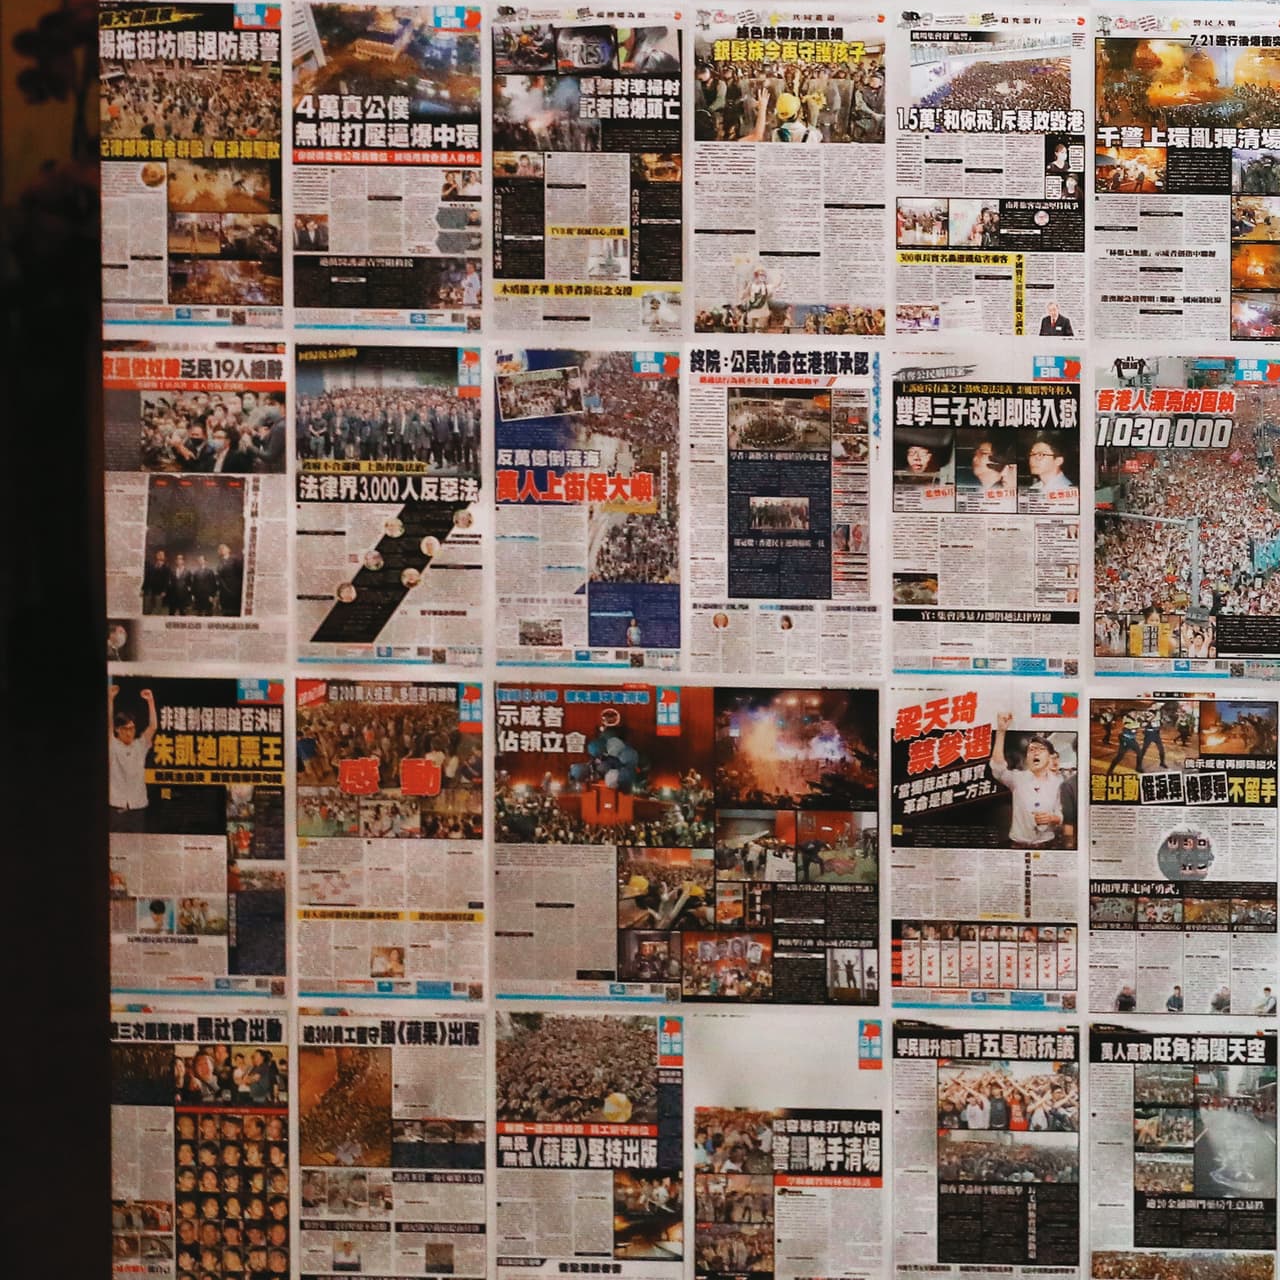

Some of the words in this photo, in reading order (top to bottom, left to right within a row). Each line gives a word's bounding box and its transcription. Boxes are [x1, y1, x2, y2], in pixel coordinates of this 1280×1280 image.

[295, 94, 410, 122] 4萬真公僕
[1096, 417, 1232, 449] 1,030,000
[497, 706, 566, 728] 示威者
[498, 731, 587, 754] 佔領立會
